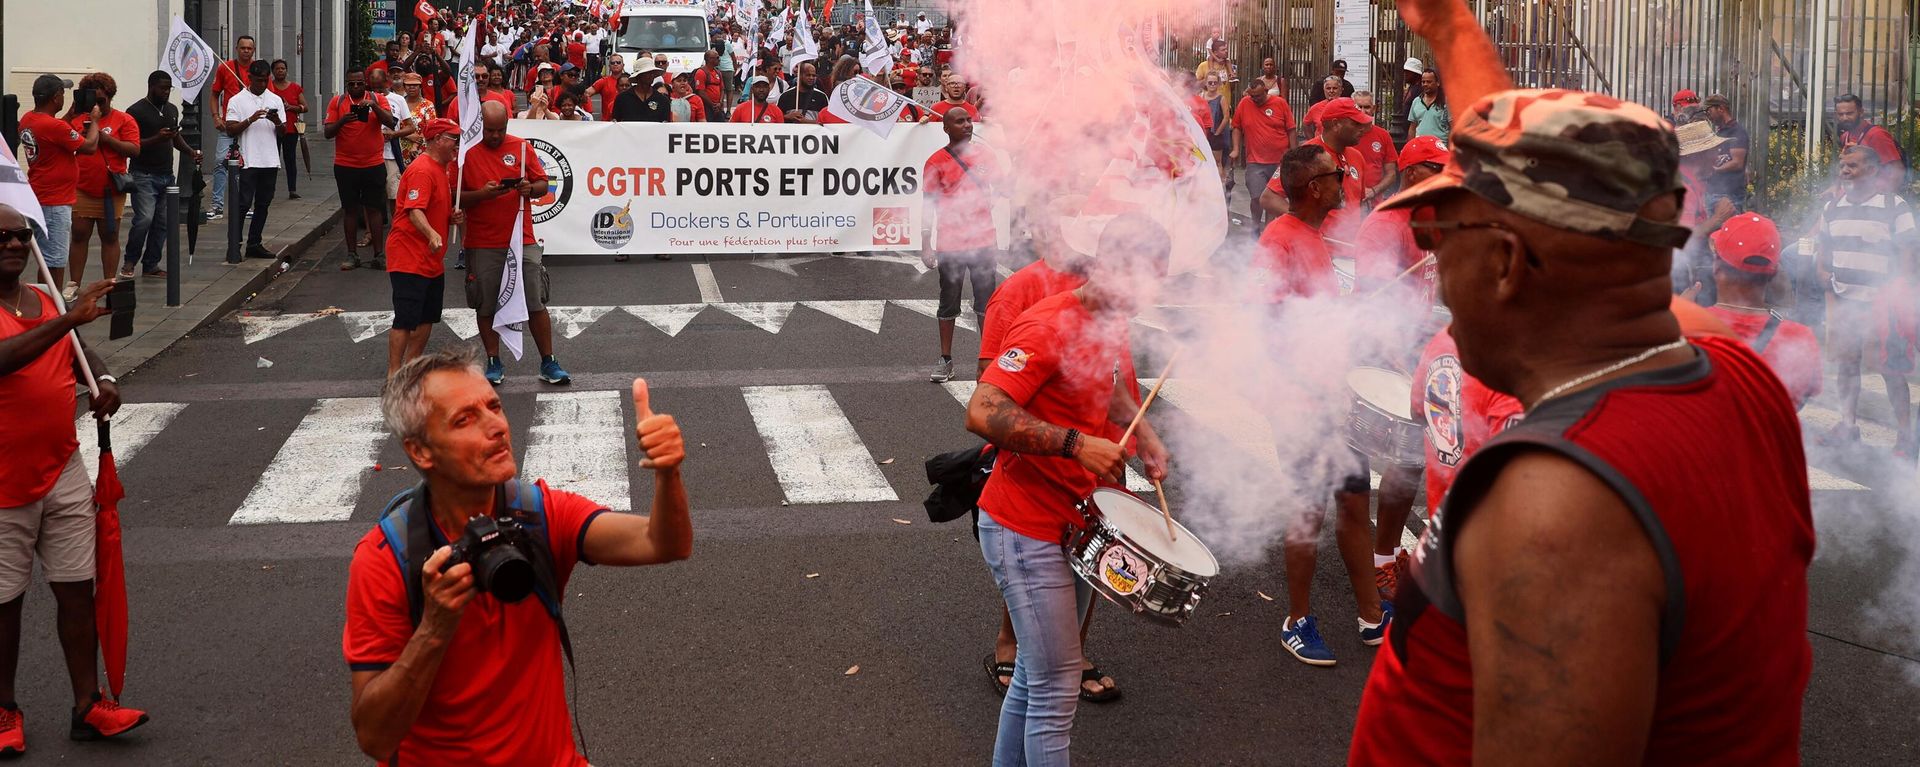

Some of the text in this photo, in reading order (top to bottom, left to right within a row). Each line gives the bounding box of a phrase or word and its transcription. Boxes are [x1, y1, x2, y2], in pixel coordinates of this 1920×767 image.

[668, 133, 839, 154] FEDERATION
[533, 140, 571, 178] PORTS ET DOCKS
[587, 166, 917, 196] CGTR PORTS ET DOCKS
[651, 212, 856, 229] Dockers & Portuaires
[872, 218, 911, 244] cgt
[669, 237, 695, 246] Pour
[724, 235, 781, 248] fédération
[786, 236, 808, 250] plus
[812, 236, 839, 247] forte
